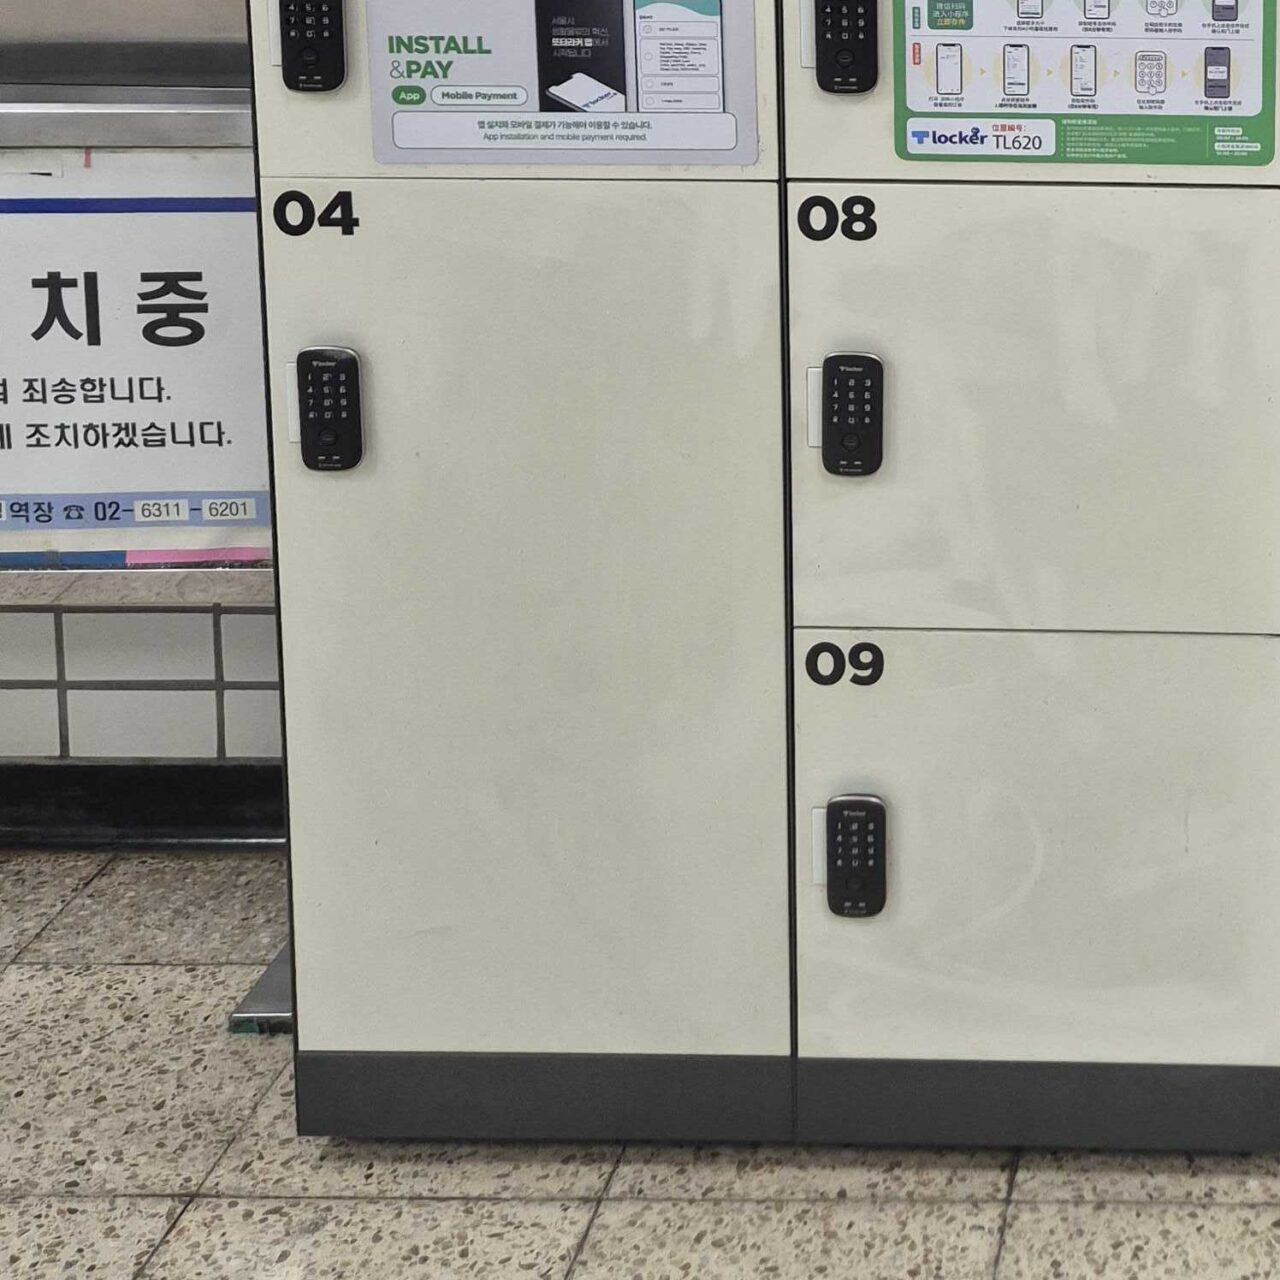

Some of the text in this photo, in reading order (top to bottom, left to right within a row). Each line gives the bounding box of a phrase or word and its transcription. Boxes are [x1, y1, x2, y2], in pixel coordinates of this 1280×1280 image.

[387, 35, 491, 54] INSTALL
[390, 60, 453, 79] &PAY
[399, 91, 421, 103] App
[442, 92, 518, 102] Mobile Payment
[483, 132, 498, 142] App
[540, 132, 554, 142] and
[993, 134, 1042, 151] TL620
[273, 190, 360, 236] 04
[797, 195, 877, 241] 08
[22, 377, 172, 405] 죄송합니다.
[26, 421, 232, 449] 조치하겠습니다.
[10, 501, 54, 522] 역장
[805, 642, 884, 686] 09
